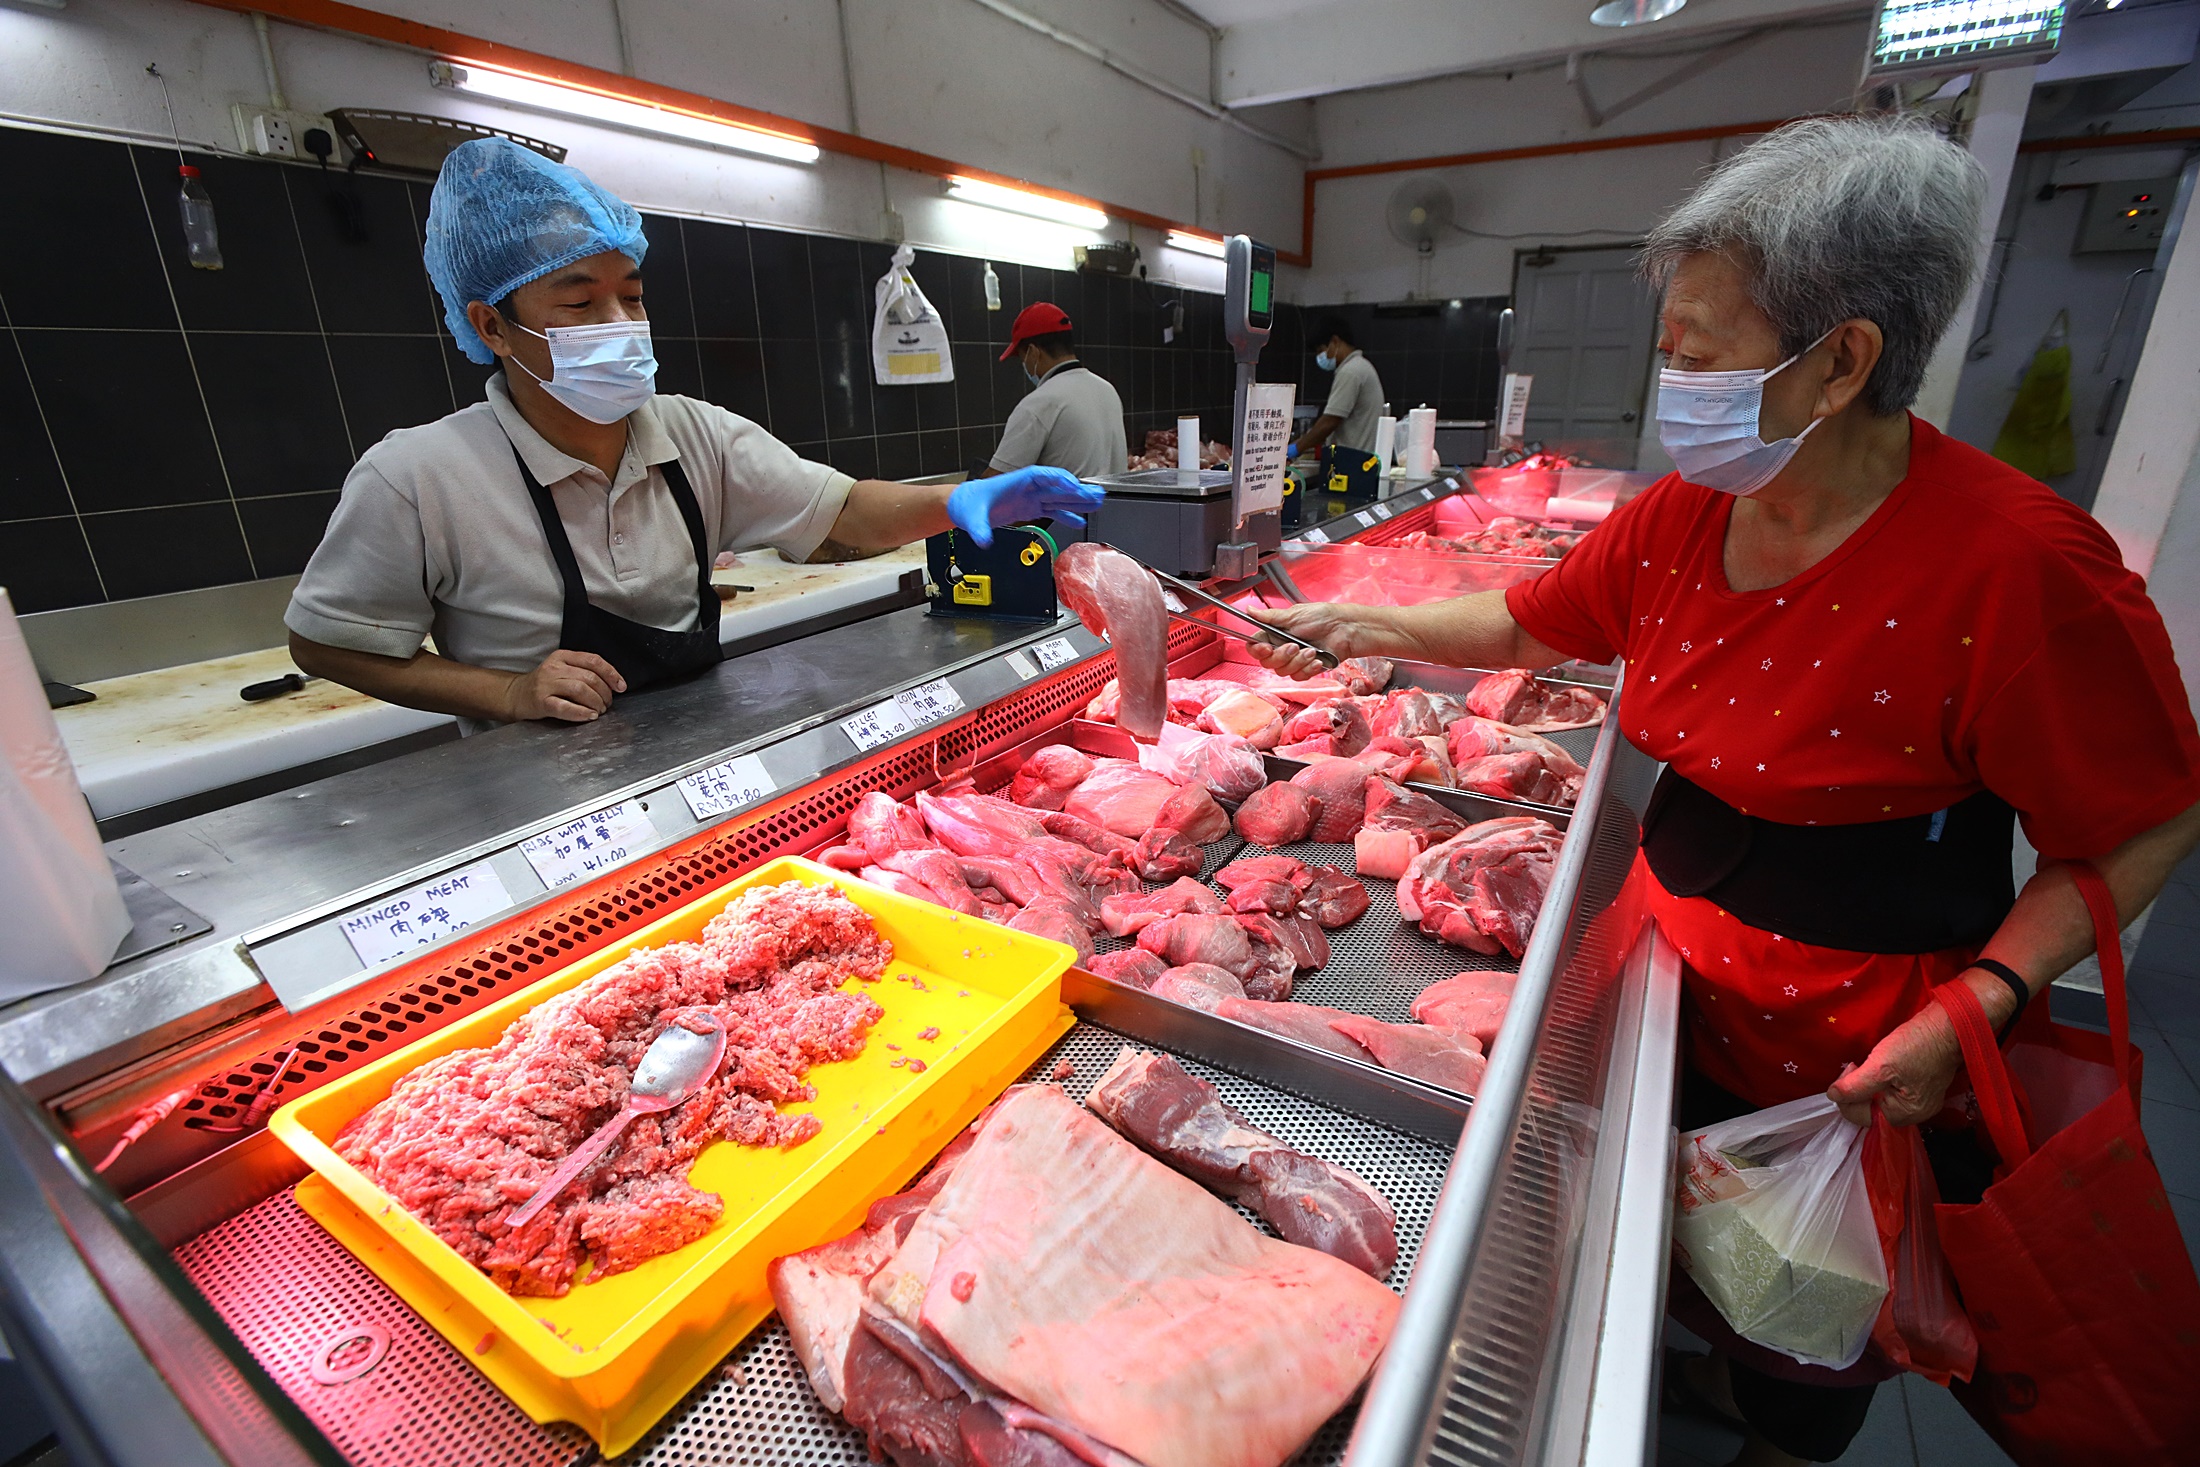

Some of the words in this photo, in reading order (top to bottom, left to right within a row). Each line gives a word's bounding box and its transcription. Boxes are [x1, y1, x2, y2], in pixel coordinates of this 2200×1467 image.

[920, 682, 943, 695] PORK
[848, 710, 878, 731] FILLET
[880, 722, 905, 742] 33.00
[685, 762, 735, 787] BELLY
[590, 805, 624, 824] BELLY
[583, 847, 627, 871] 41.00
[347, 900, 411, 933] MINCED
[425, 876, 470, 901] MEAT
